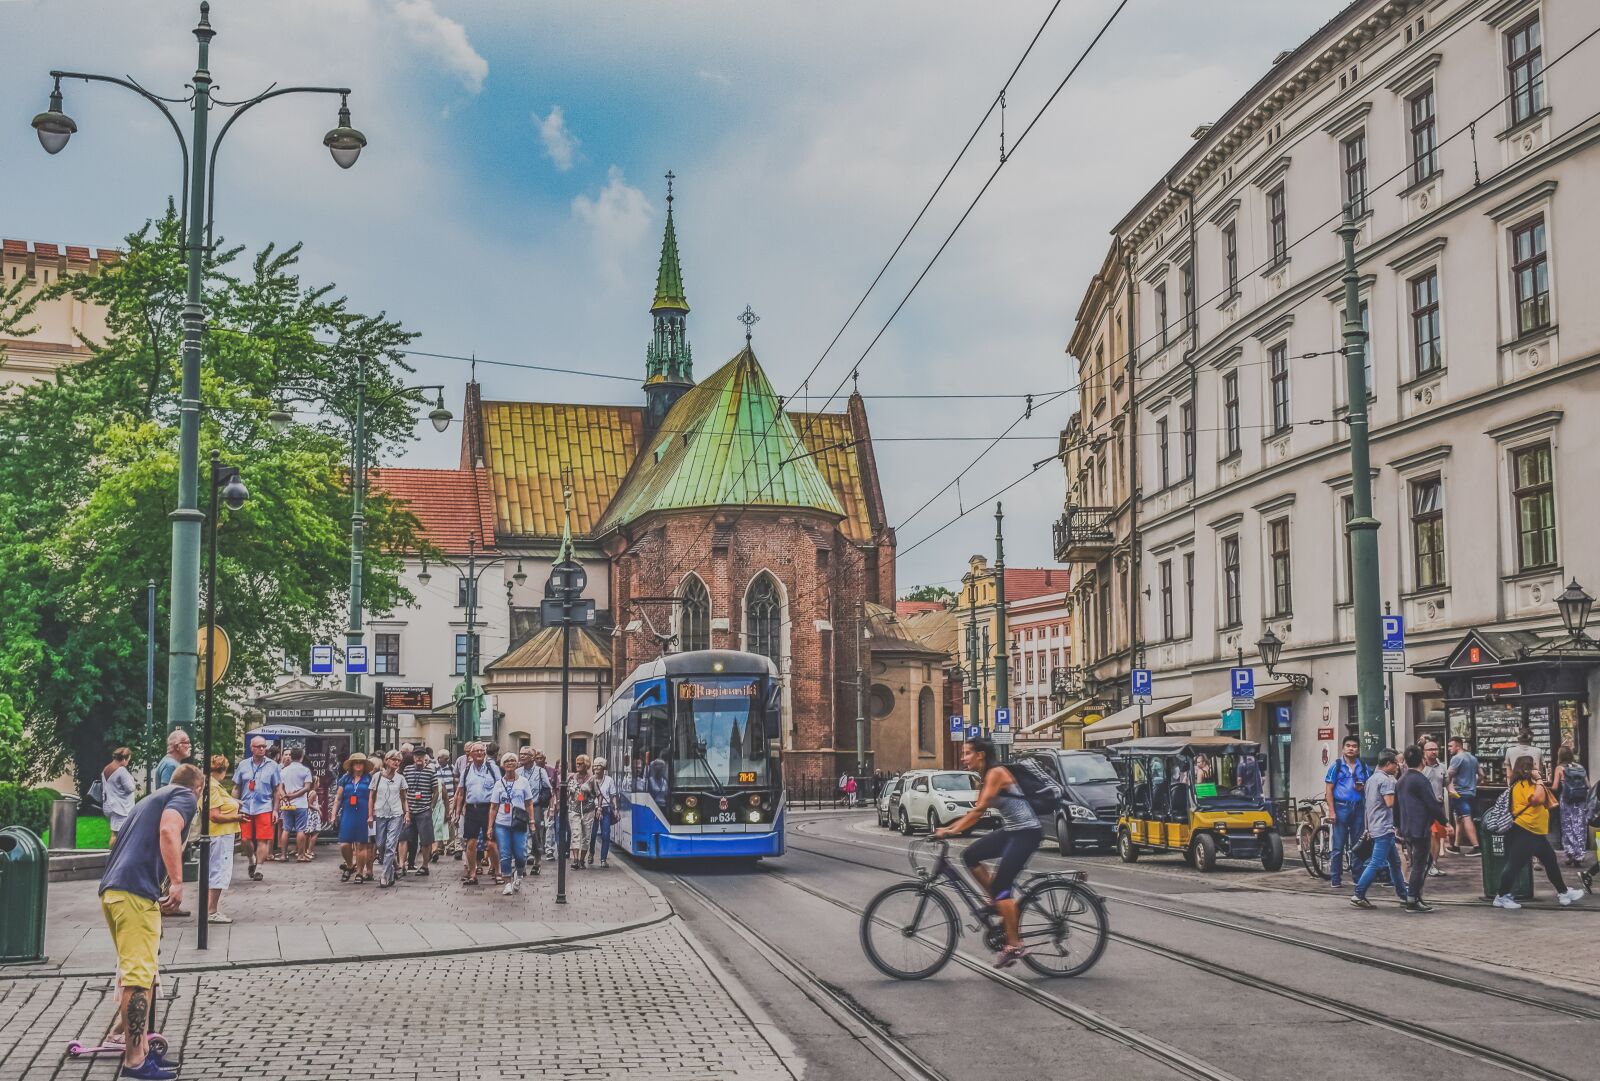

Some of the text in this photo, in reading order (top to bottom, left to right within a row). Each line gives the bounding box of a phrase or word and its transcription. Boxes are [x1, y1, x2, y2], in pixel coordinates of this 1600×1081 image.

[1382, 618, 1399, 641] P
[1136, 671, 1148, 688] P
[1236, 670, 1250, 690] P
[953, 717, 961, 728] P
[997, 710, 1007, 723] P
[971, 726, 979, 737] P
